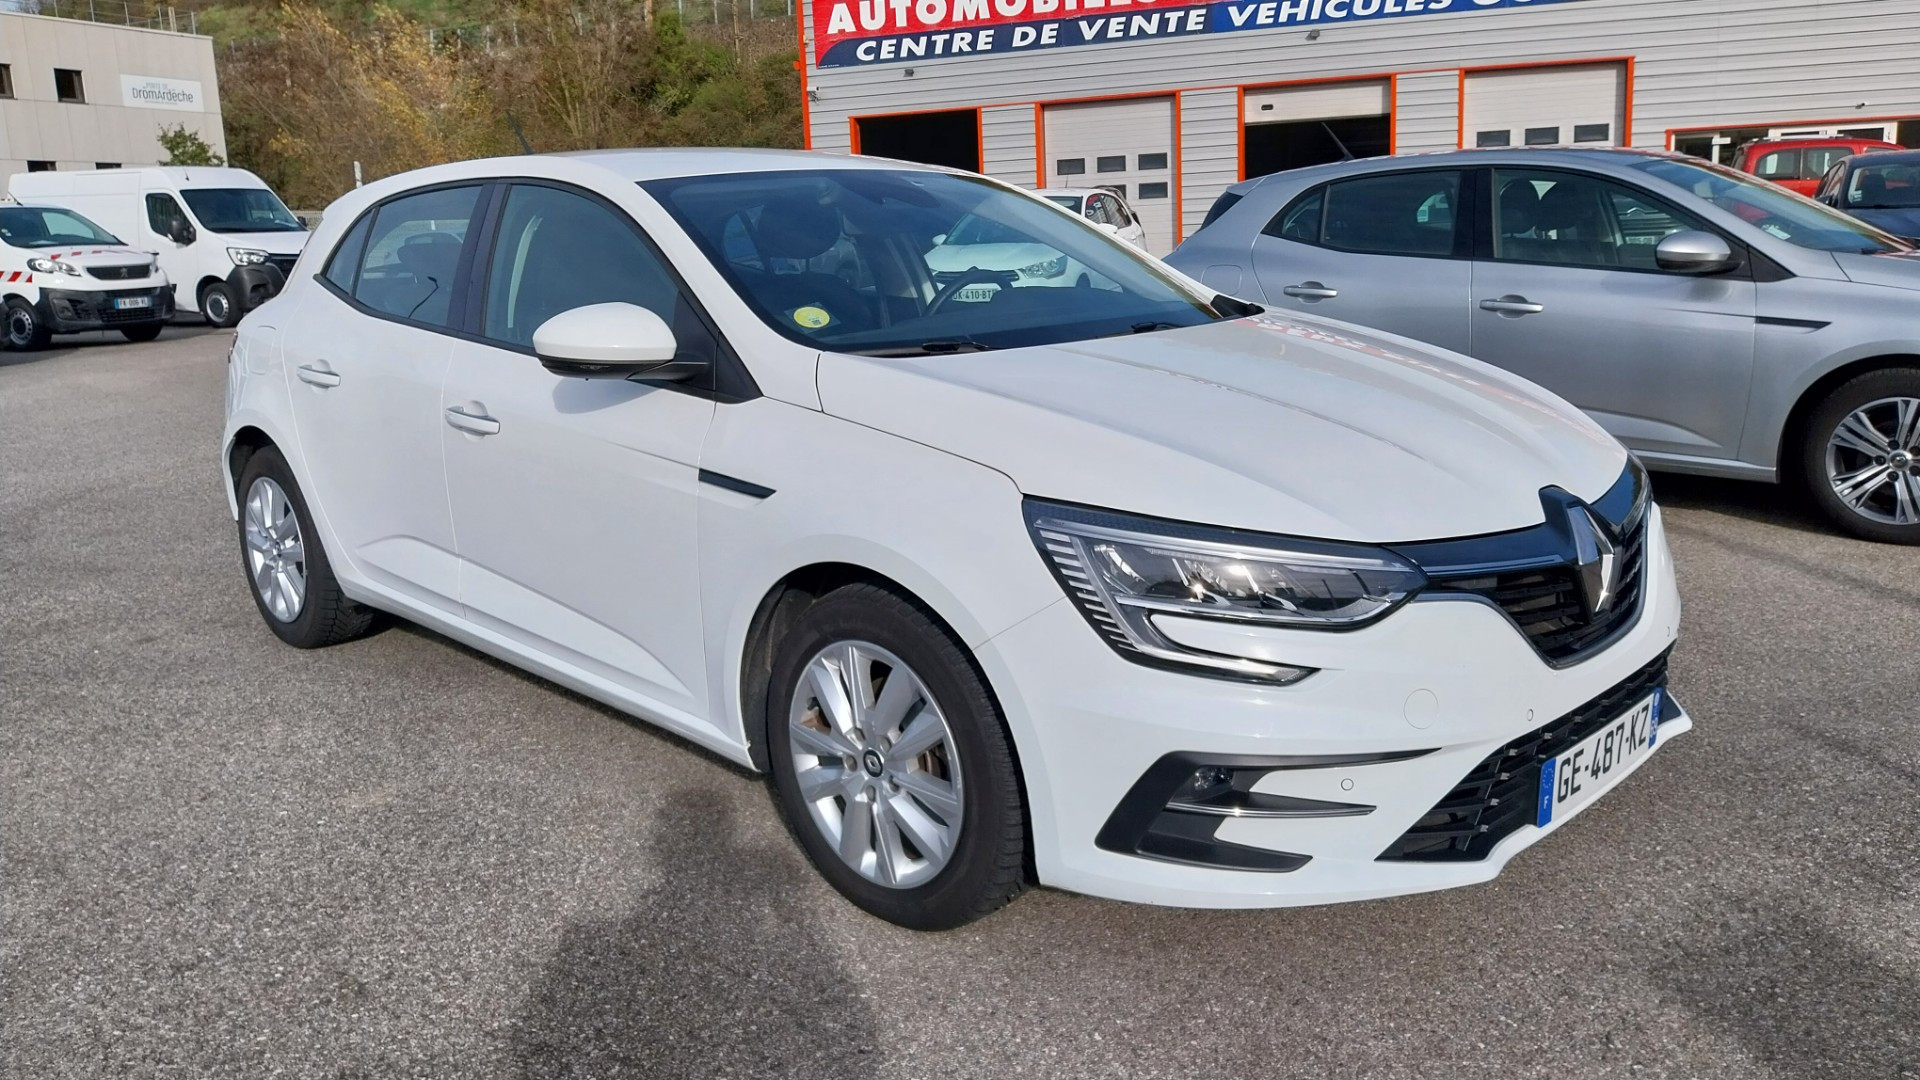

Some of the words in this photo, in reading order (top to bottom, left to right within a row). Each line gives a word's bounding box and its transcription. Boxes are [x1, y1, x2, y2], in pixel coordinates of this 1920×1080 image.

[827, 0, 1134, 34] AUTOMO
[855, 29, 995, 62] CENTRE
[1012, 23, 1059, 48] DE
[1078, 9, 1207, 40] VENTE
[1557, 703, 1650, 804] GE-487-KZ
